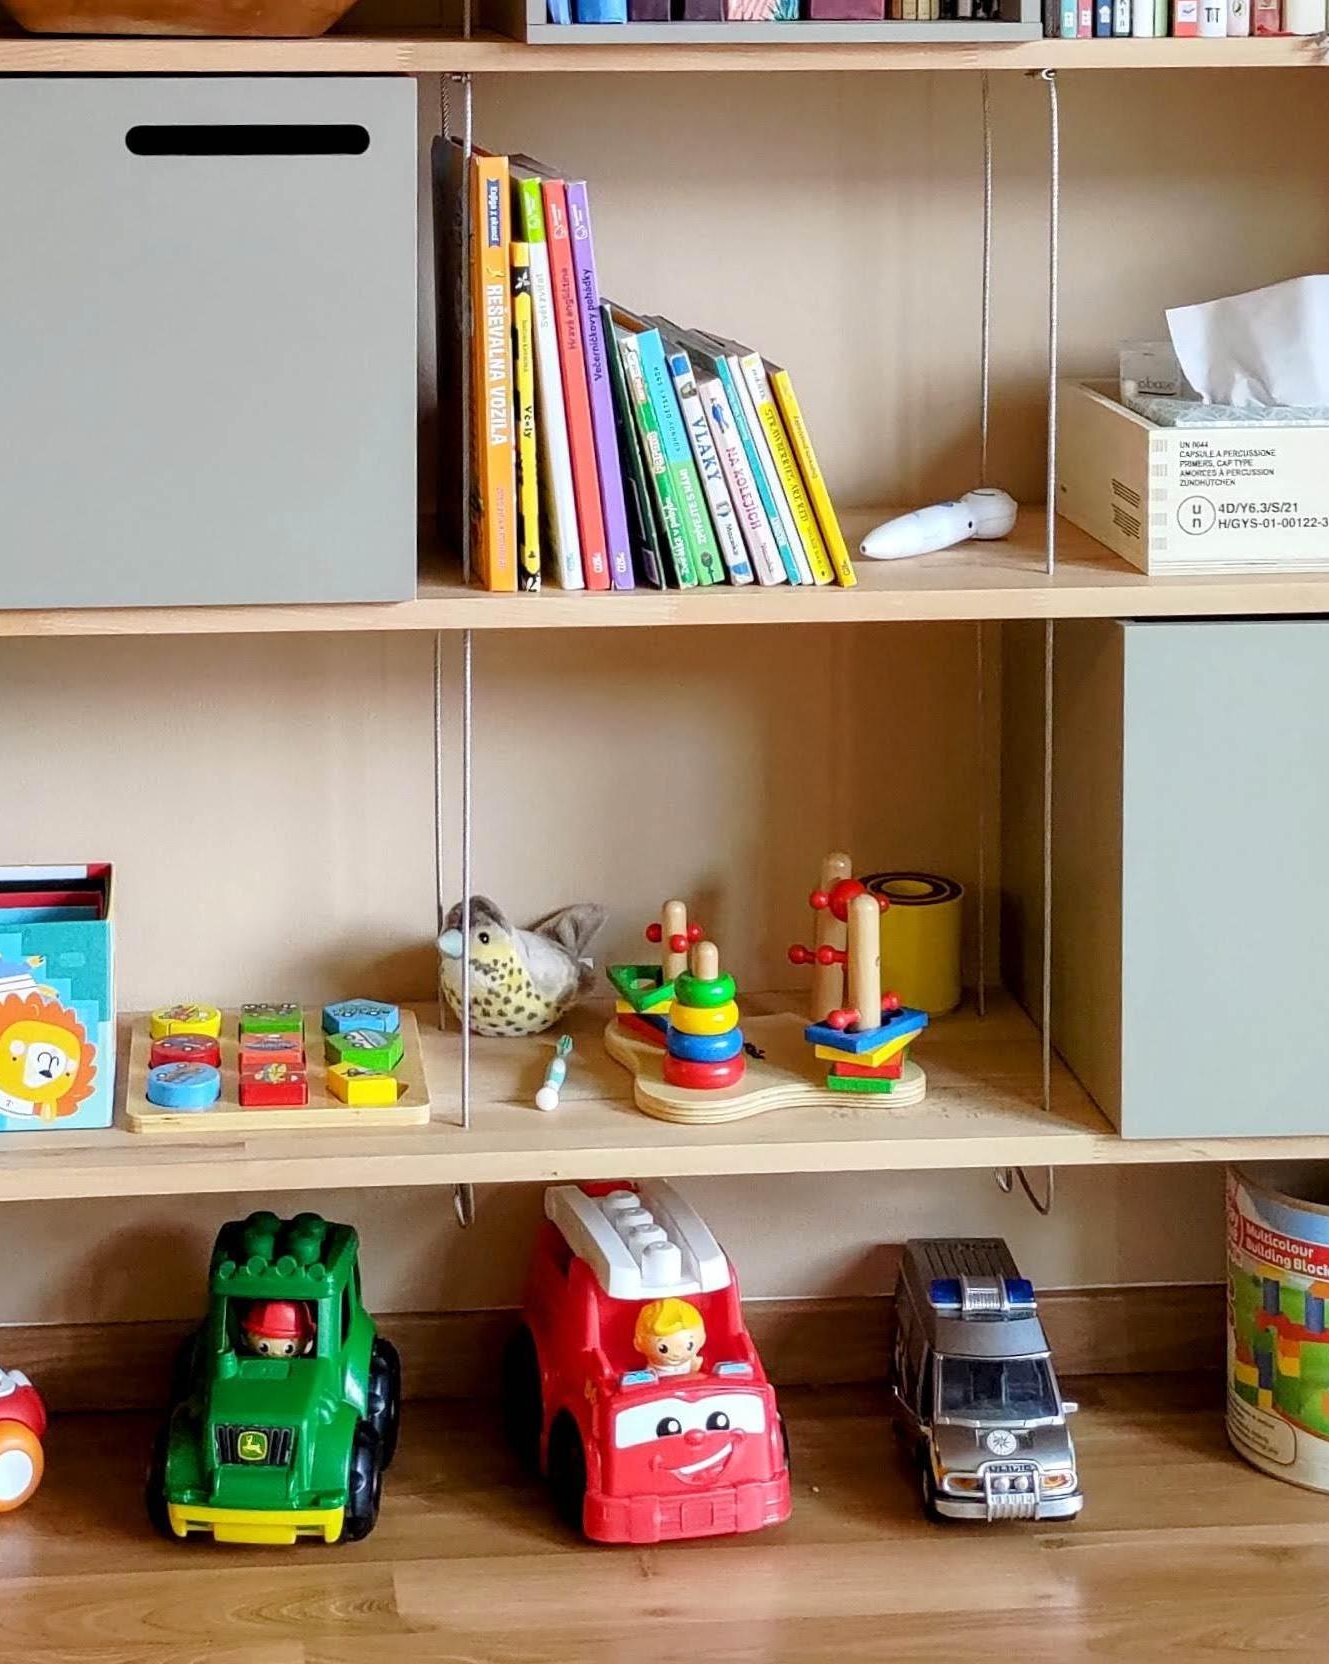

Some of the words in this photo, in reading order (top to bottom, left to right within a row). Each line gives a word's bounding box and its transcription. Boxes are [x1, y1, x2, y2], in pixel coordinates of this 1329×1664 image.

[581, 269, 596, 311] pohádky
[486, 283, 508, 379] REŠEVALNA
[588, 313, 602, 382] Večerníčkovy
[489, 385, 508, 446] VOZILA
[691, 415, 722, 482] VLAKY
[1179, 441, 1190, 449] UN
[1234, 459, 1254, 467] TYPE
[725, 446, 740, 468] NA
[733, 469, 762, 531] KOLEJÍCH
[1218, 502, 1299, 514] 4D/Y6.3/S/21
[1245, 1221, 1314, 1258] Multicolour
[1245, 1237, 1291, 1269] Building
